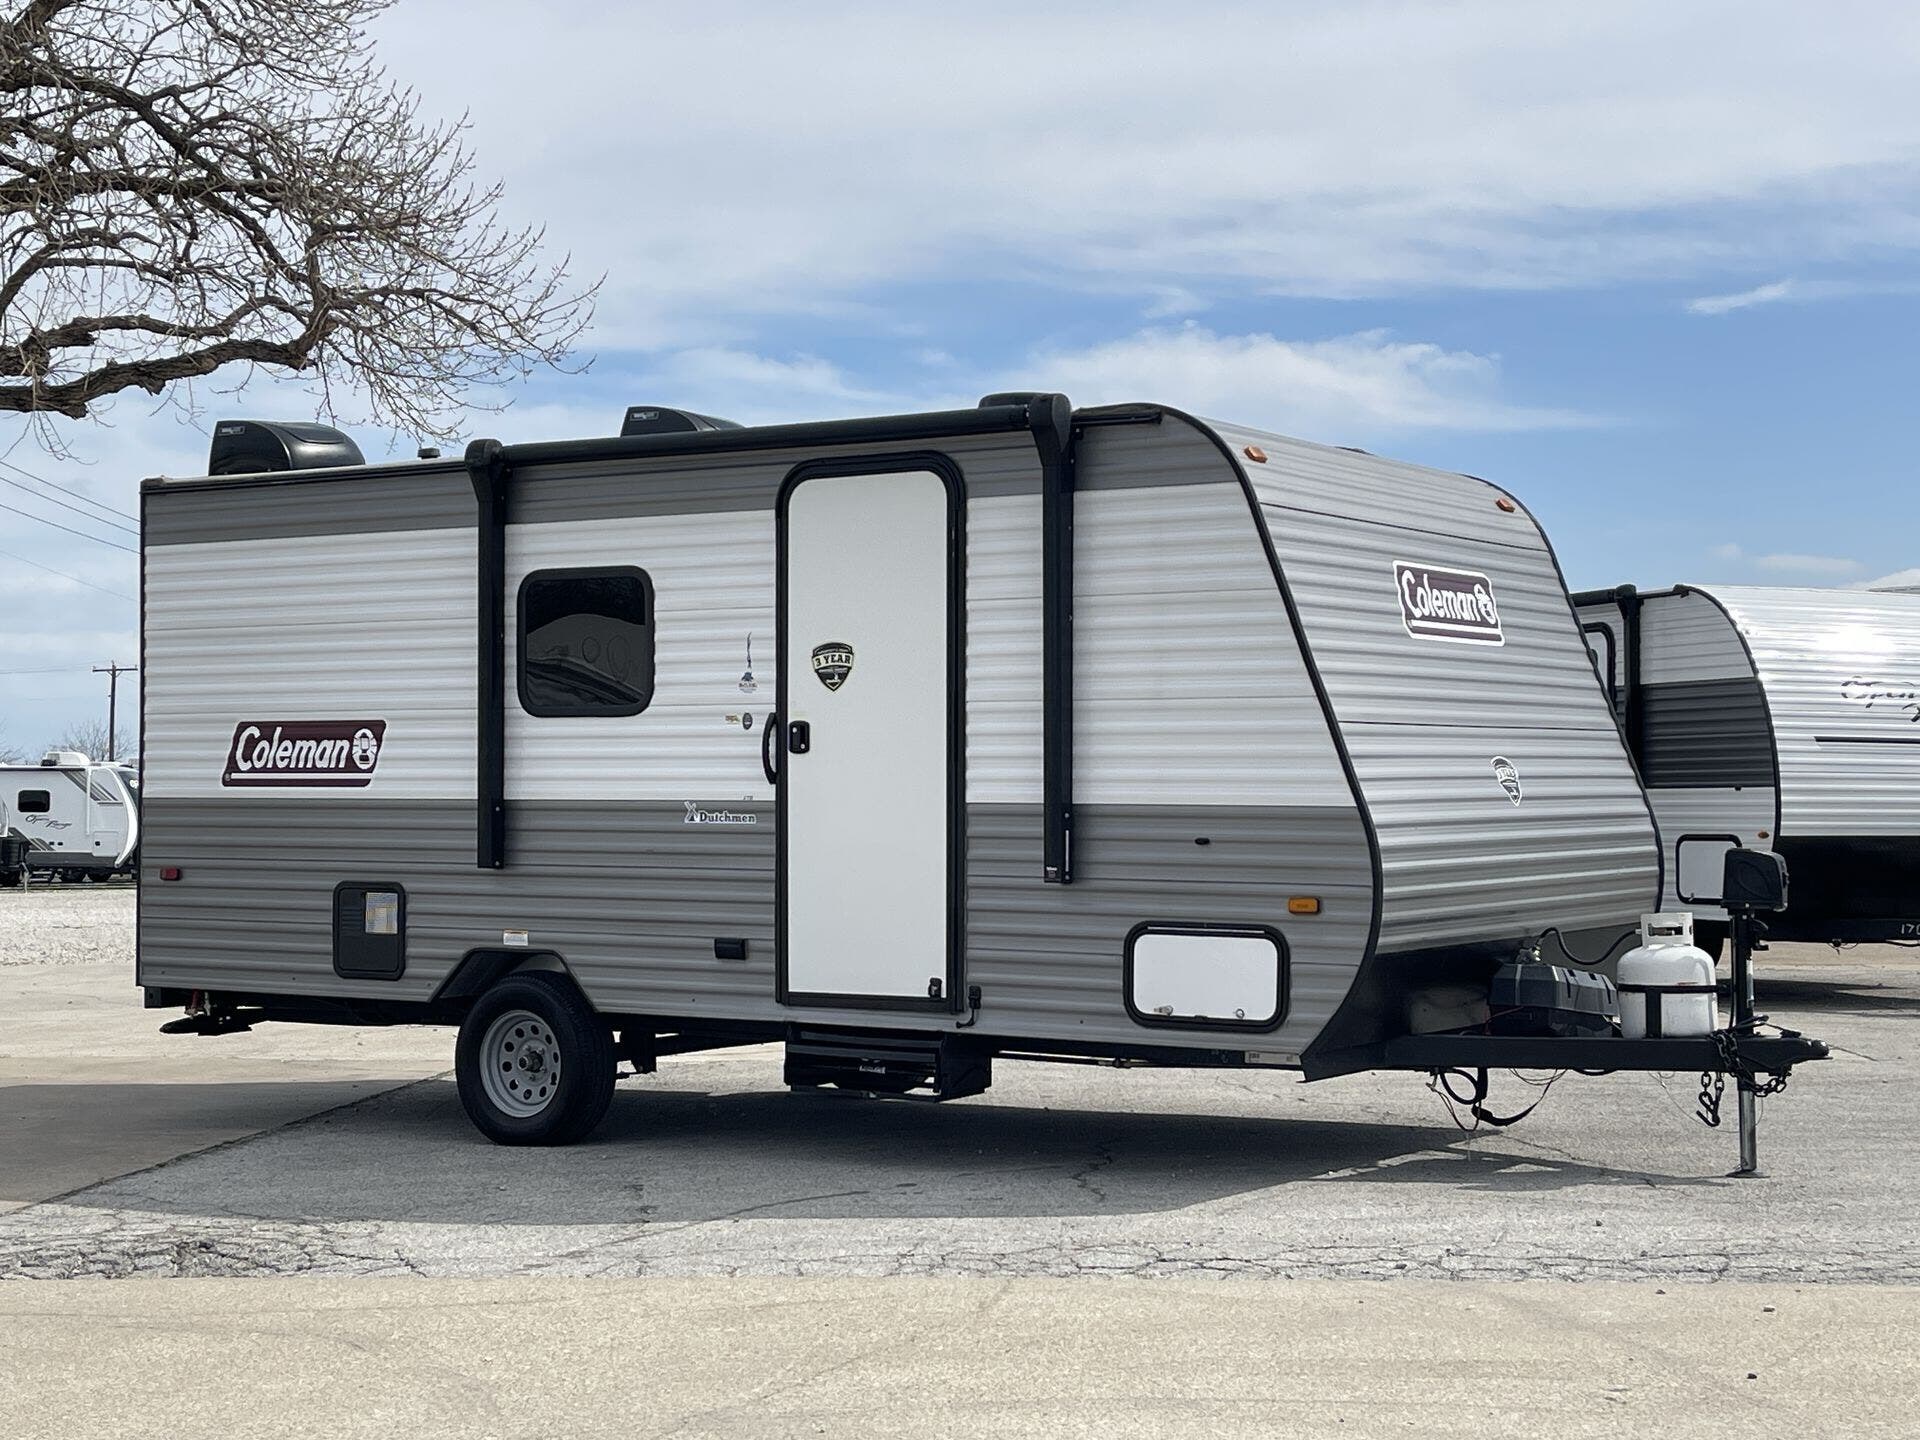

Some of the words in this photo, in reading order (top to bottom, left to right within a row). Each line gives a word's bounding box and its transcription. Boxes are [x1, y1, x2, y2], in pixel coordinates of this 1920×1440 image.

[1402, 570, 1481, 621] Coleman
[823, 654, 851, 664] YEAR
[236, 726, 350, 771] Coleman
[699, 811, 755, 823] Dutchmen
